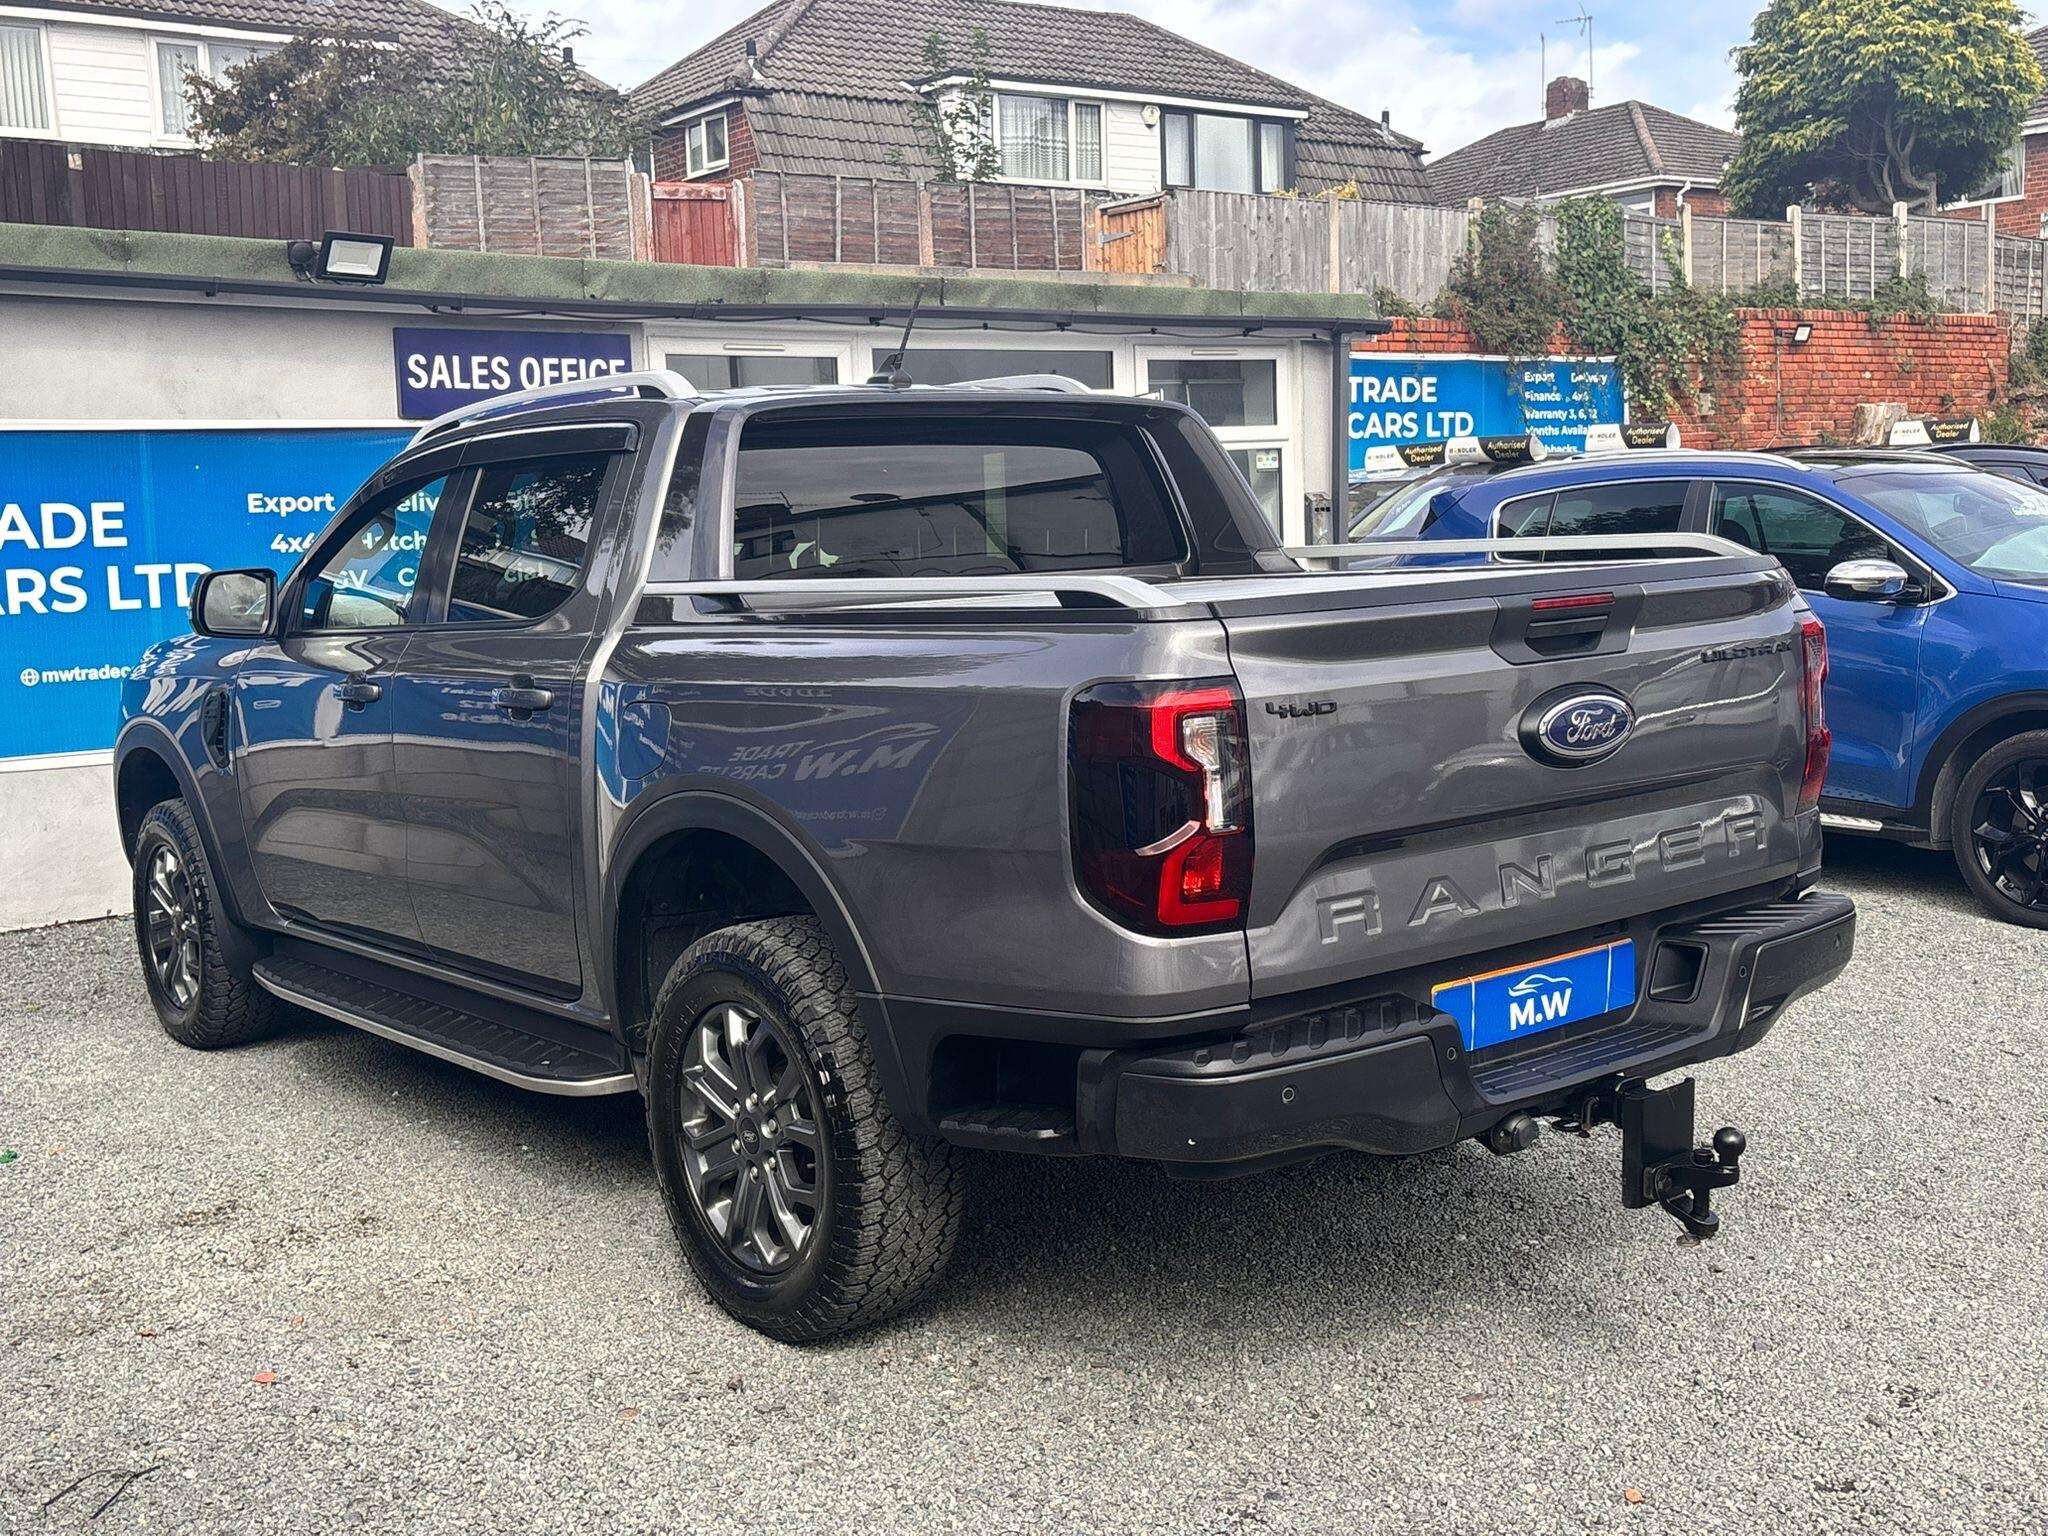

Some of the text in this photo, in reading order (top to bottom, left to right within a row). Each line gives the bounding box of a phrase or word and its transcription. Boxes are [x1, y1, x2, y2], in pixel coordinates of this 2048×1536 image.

[407, 354, 511, 391] SALES
[1348, 376, 1438, 403] TRADE
[1348, 411, 1475, 439] CARS LTD
[1525, 409, 1568, 421] Warranty
[1568, 408, 1577, 420] 3,
[1578, 408, 1587, 420] 6,
[1561, 424, 1589, 435] Availa
[247, 493, 336, 518] Export
[0, 566, 88, 615] RS
[1264, 701, 1338, 719] 4WD
[1566, 708, 1616, 744] Ford
[1316, 808, 1768, 945] RANGER
[1509, 986, 1573, 1032] M.W
